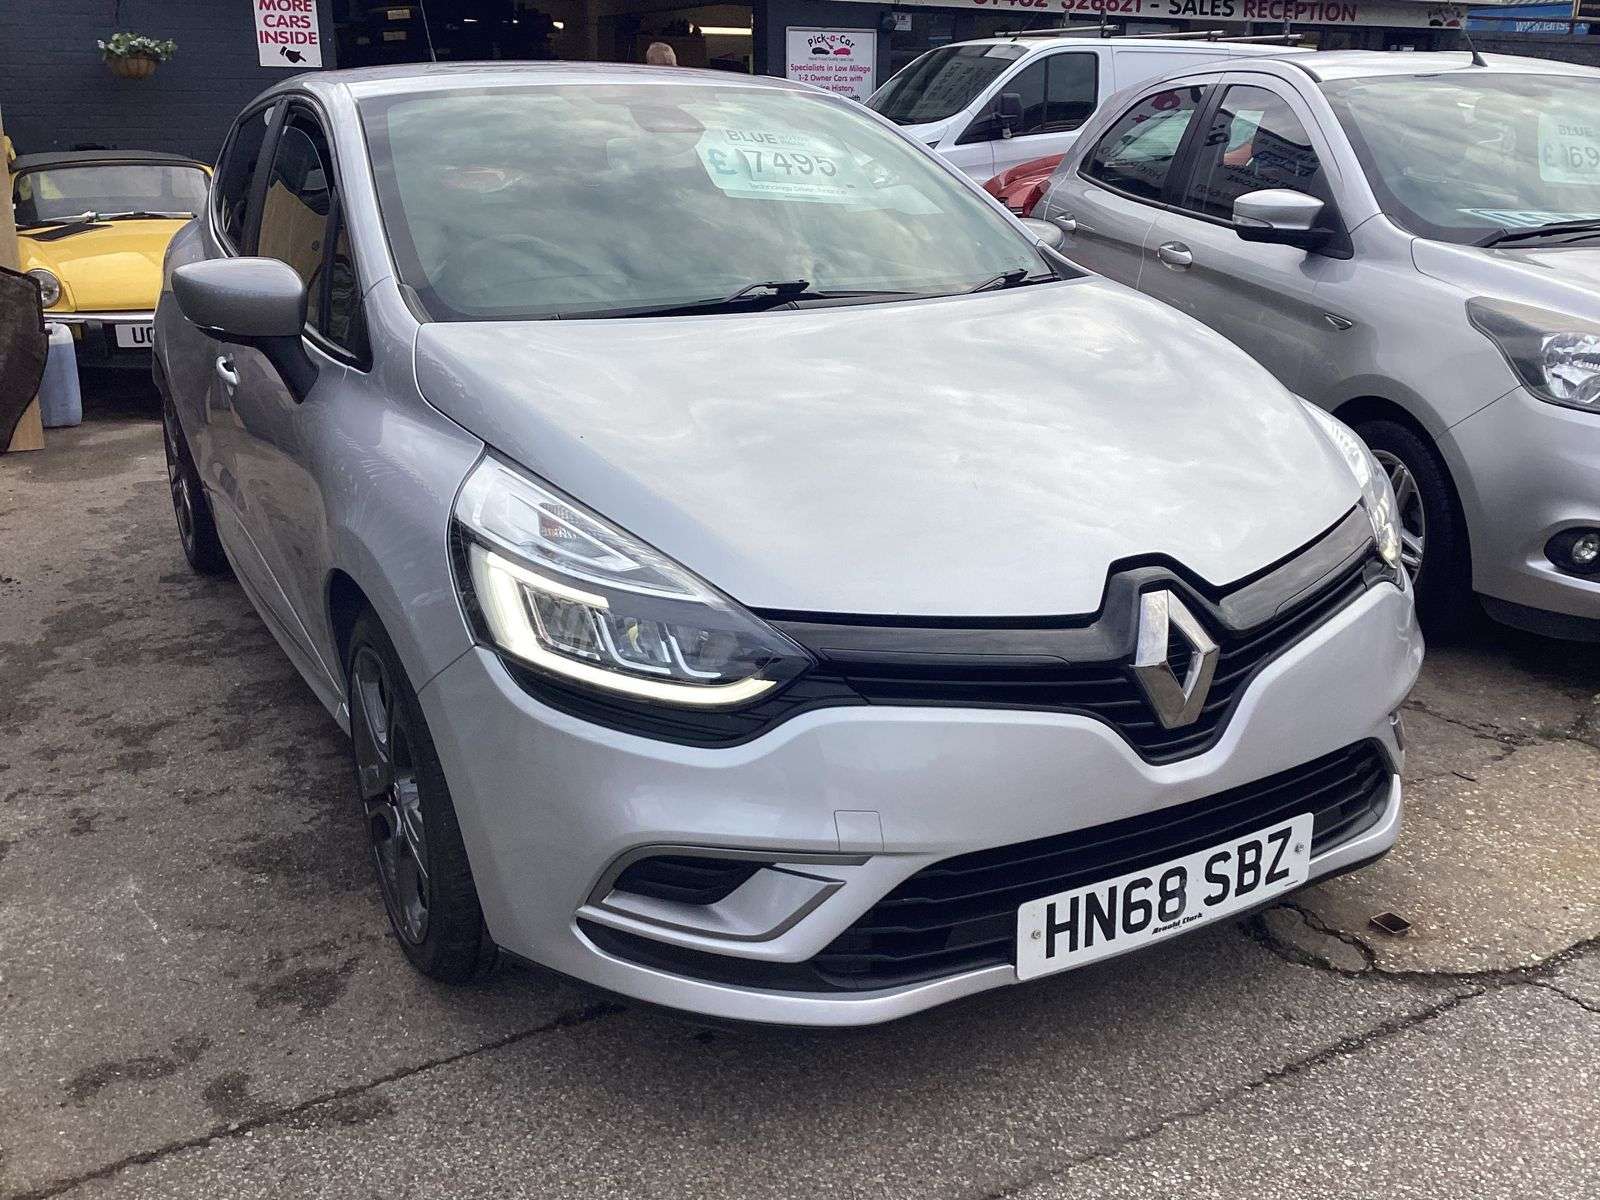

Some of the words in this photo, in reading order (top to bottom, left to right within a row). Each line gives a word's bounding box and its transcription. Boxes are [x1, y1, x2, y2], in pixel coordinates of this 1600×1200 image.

[258, 0, 313, 12] MORE
[1168, 0, 1235, 17] SALES
[1242, 0, 1357, 22] RECEPTION
[263, 14, 311, 28] CARS
[259, 31, 318, 44] INSIDE
[807, 34, 856, 48] Pick-a-Car
[790, 64, 825, 74] Specialists
[827, 64, 833, 72] in
[726, 129, 778, 144] BLUE
[1046, 866, 1188, 959] HN68
[1204, 826, 1292, 907] SBZ
[1151, 920, 1181, 935] Arnold
[1182, 912, 1203, 924] Clark
